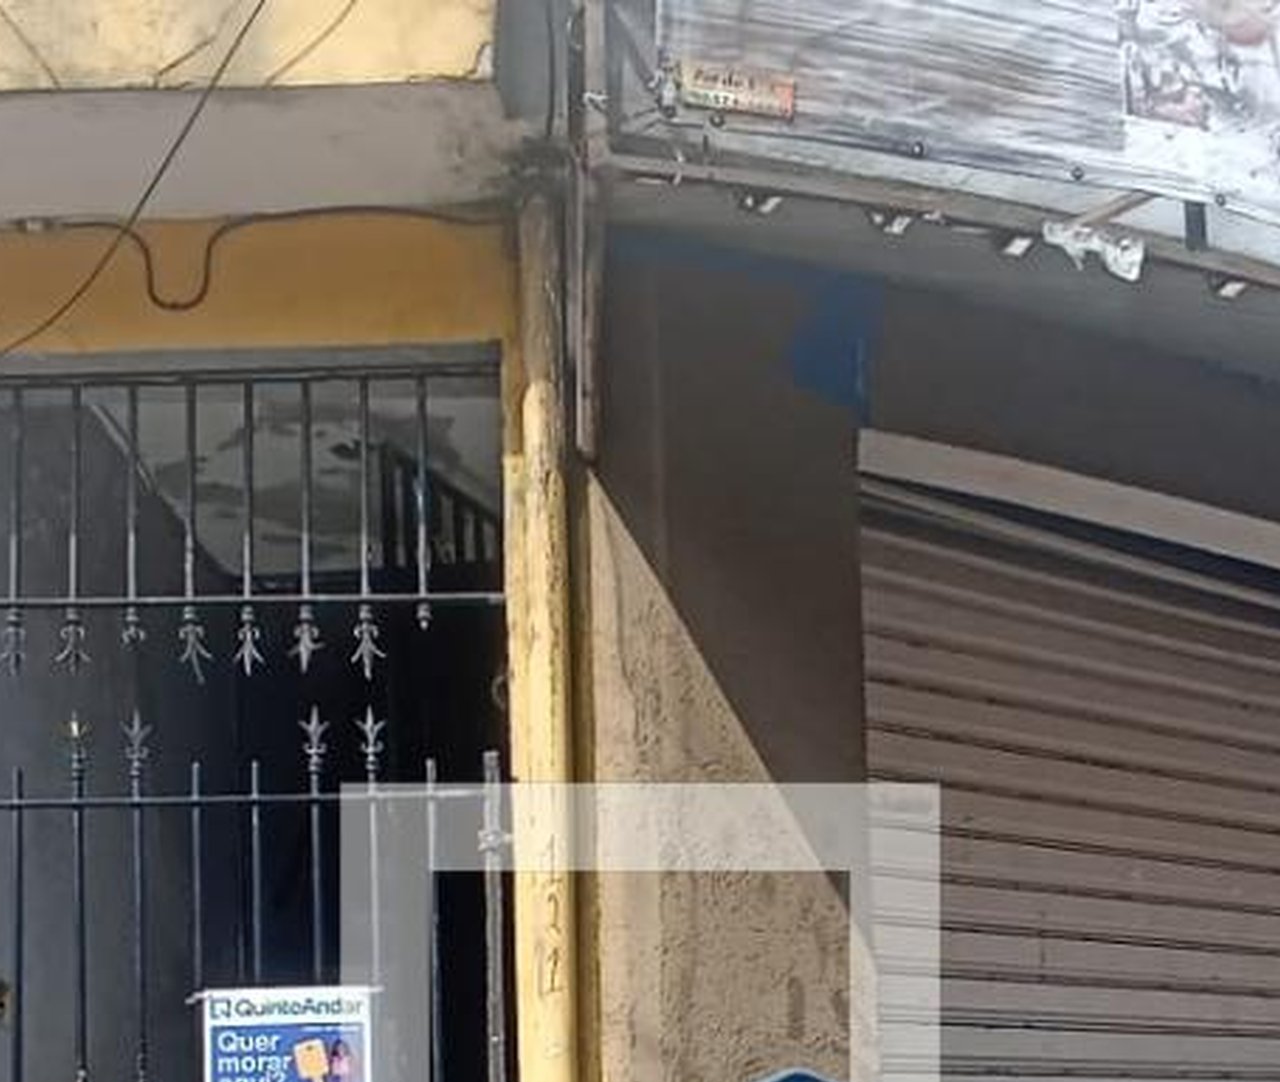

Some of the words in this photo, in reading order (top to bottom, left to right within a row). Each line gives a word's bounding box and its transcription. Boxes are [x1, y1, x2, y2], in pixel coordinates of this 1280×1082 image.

[235, 999, 363, 1018] QuintoAndar
[218, 1031, 280, 1054] Quer
[218, 1056, 292, 1073] morar
